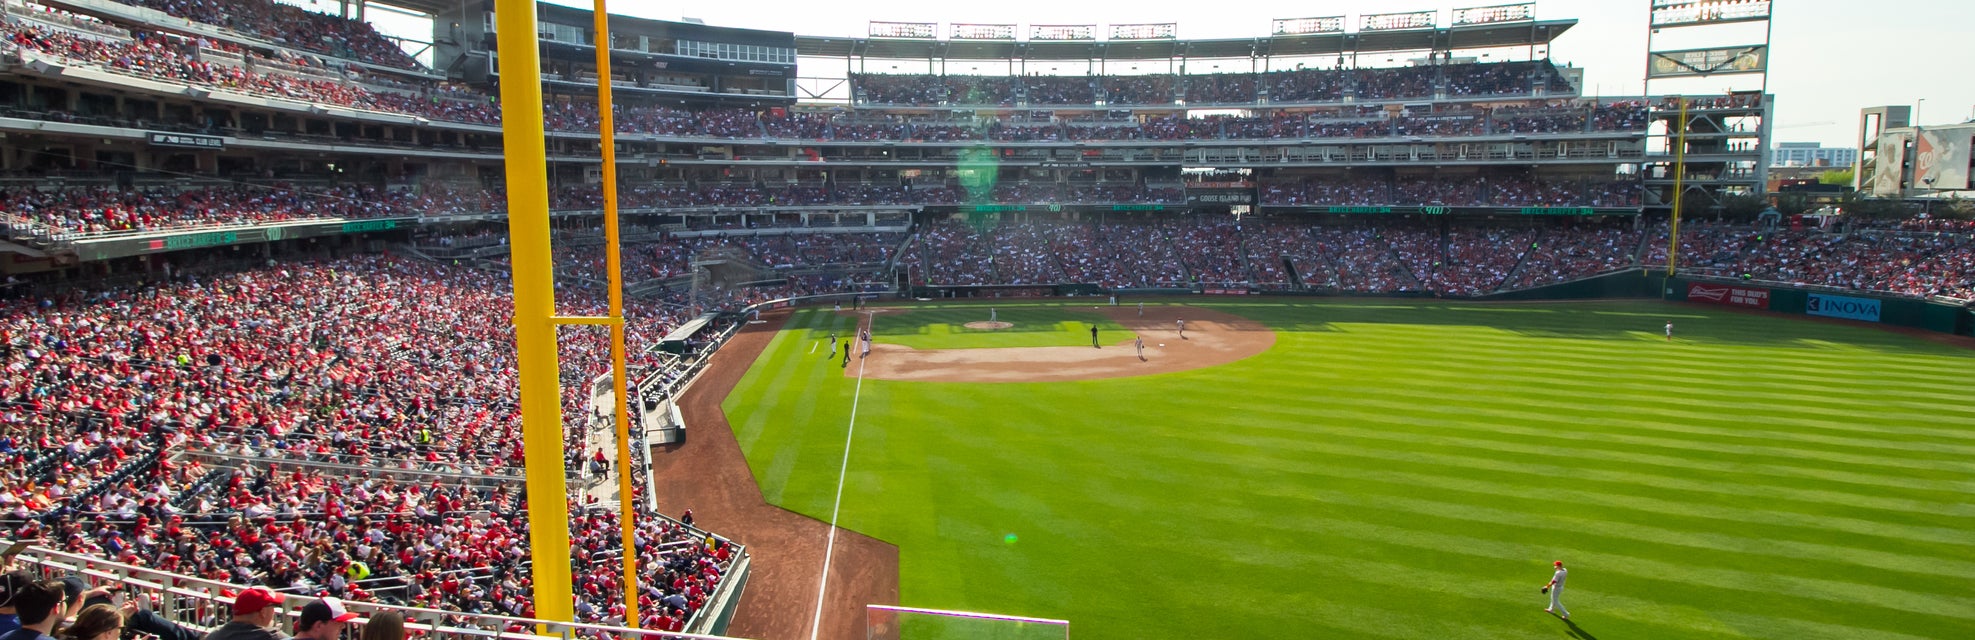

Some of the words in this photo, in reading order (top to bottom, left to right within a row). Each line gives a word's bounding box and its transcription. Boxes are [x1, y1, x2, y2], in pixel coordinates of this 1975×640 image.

[224, 231, 237, 243] 34
[1731, 288, 1746, 296] THIS
[1747, 290, 1767, 299] BUD'S
[1824, 300, 1878, 316] INOVA
